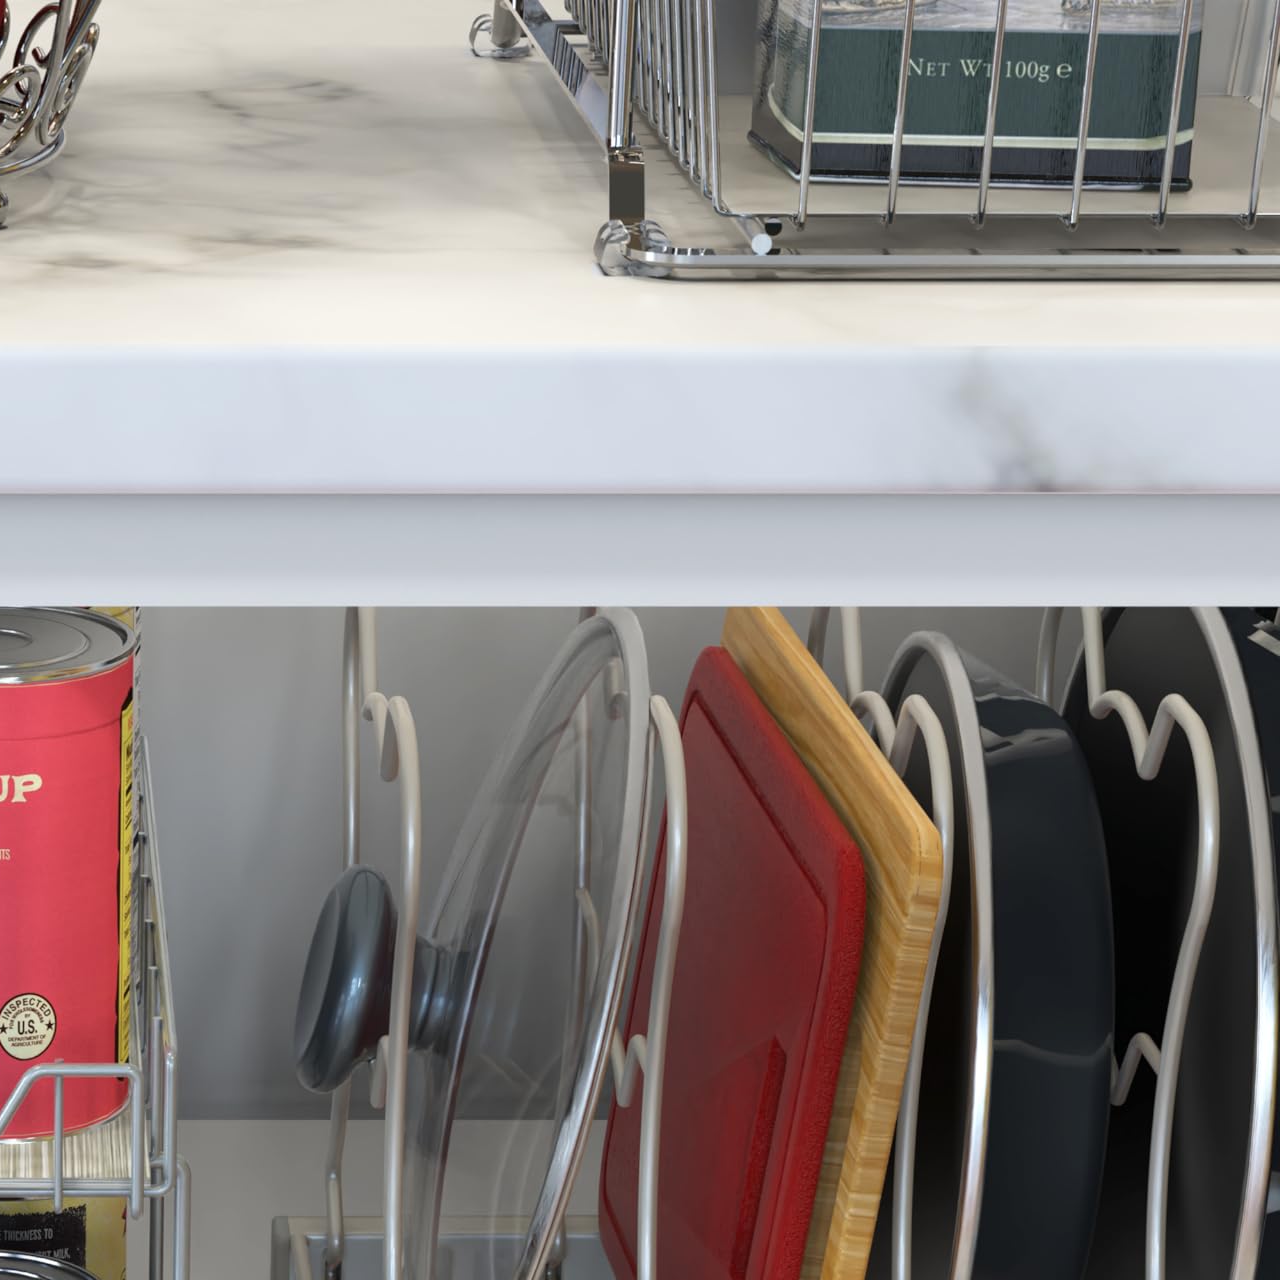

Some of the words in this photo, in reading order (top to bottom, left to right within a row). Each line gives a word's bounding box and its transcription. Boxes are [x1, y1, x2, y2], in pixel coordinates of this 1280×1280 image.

[1004, 60, 1050, 82] 100g
[1, 997, 52, 1020] INSPECTED
[17, 1019, 38, 1035] U.S.
[3, 1229, 42, 1241] THICKNESS
[44, 1228, 53, 1240] TO
